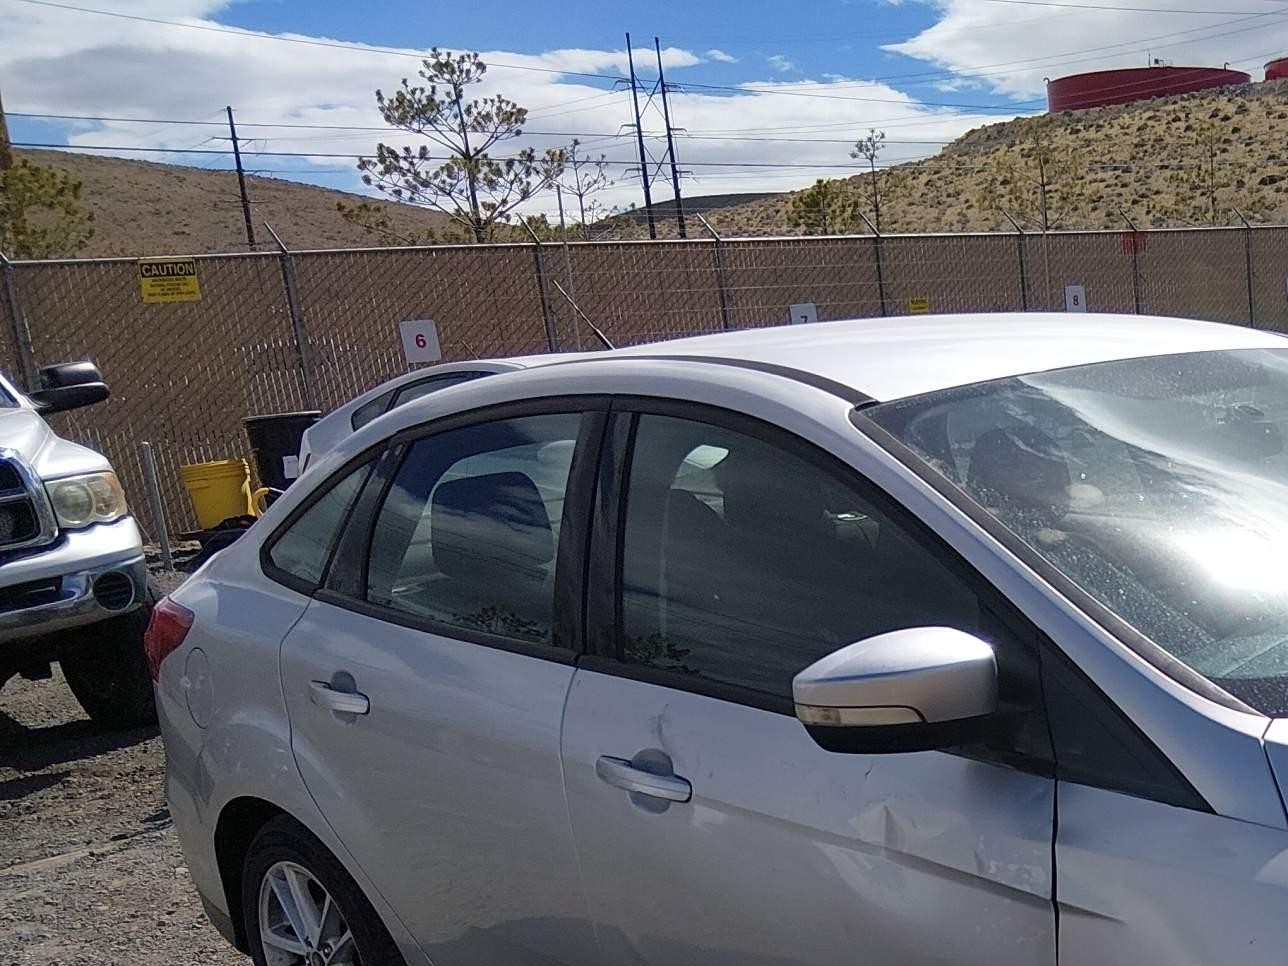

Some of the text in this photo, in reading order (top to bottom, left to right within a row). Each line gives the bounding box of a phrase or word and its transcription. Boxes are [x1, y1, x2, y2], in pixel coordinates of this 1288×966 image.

[142, 263, 194, 276] CAUTION
[1073, 295, 1079, 306] 8
[415, 333, 427, 348] 6
